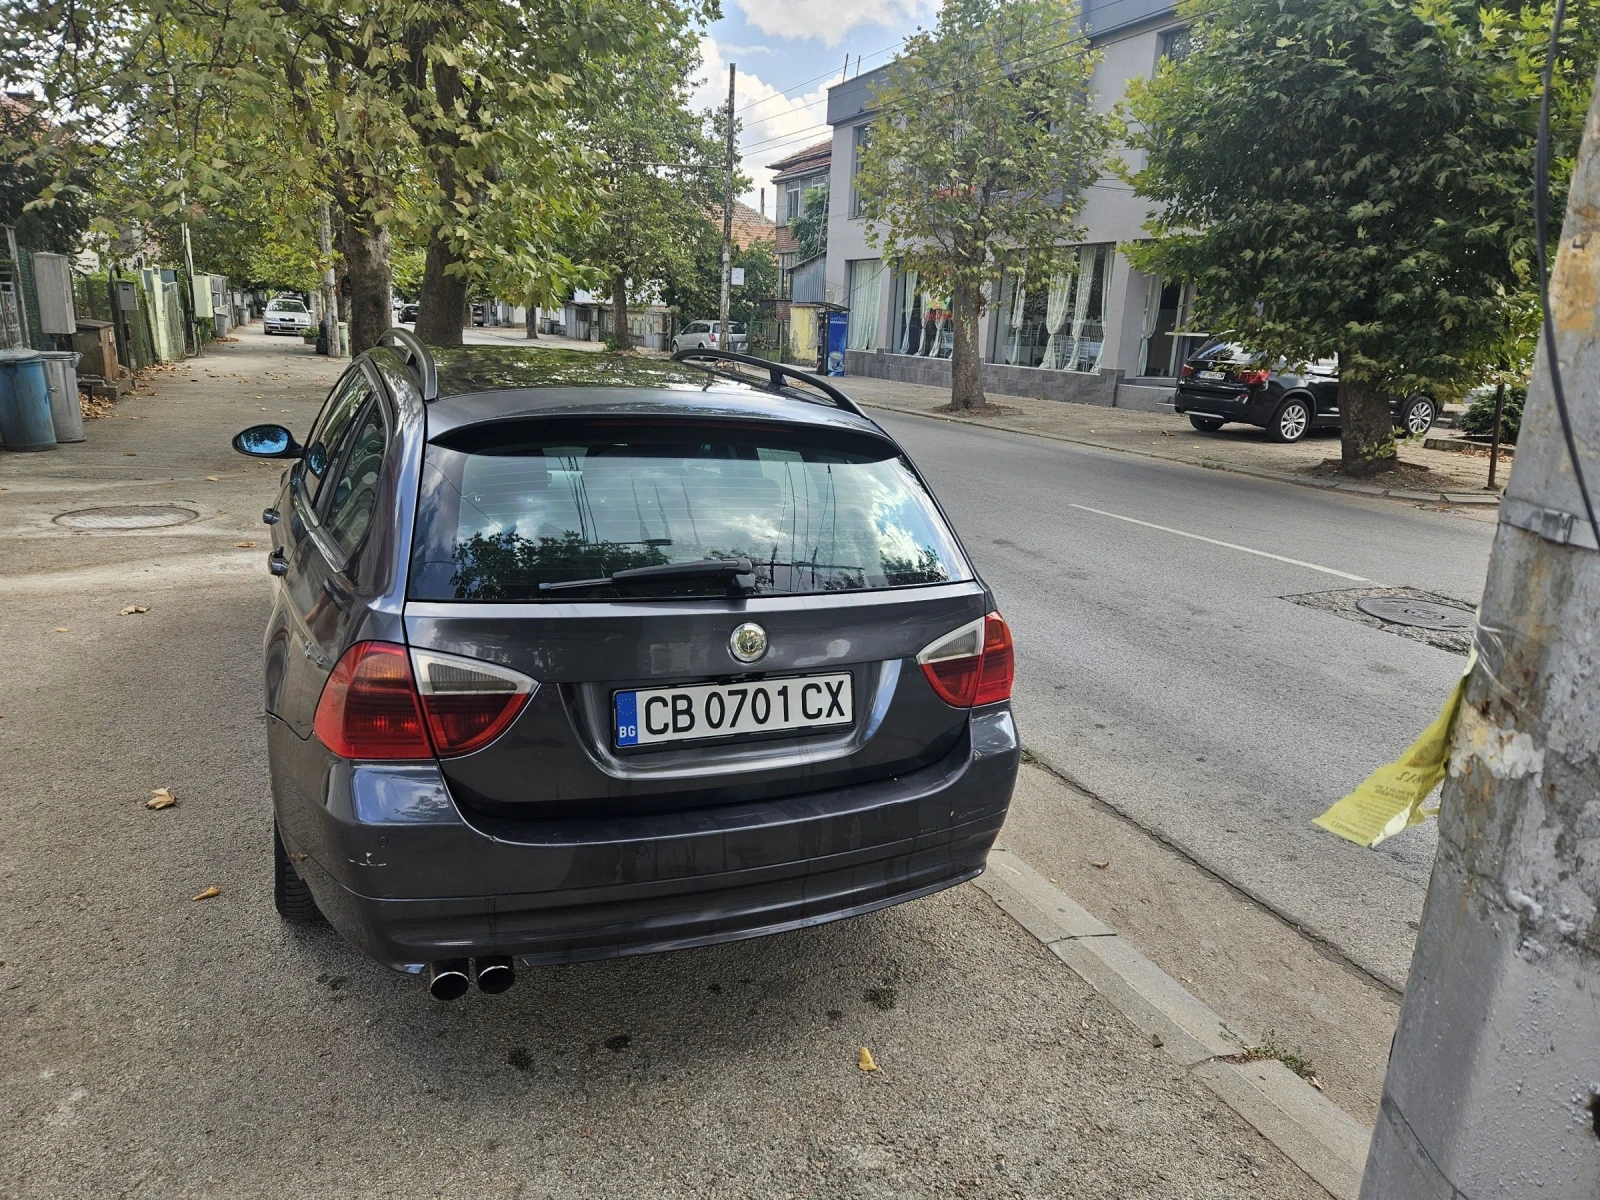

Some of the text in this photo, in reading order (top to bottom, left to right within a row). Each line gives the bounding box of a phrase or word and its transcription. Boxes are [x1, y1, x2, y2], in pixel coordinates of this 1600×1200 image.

[644, 680, 845, 736] CB 0701 CX
[619, 725, 636, 739] BG
